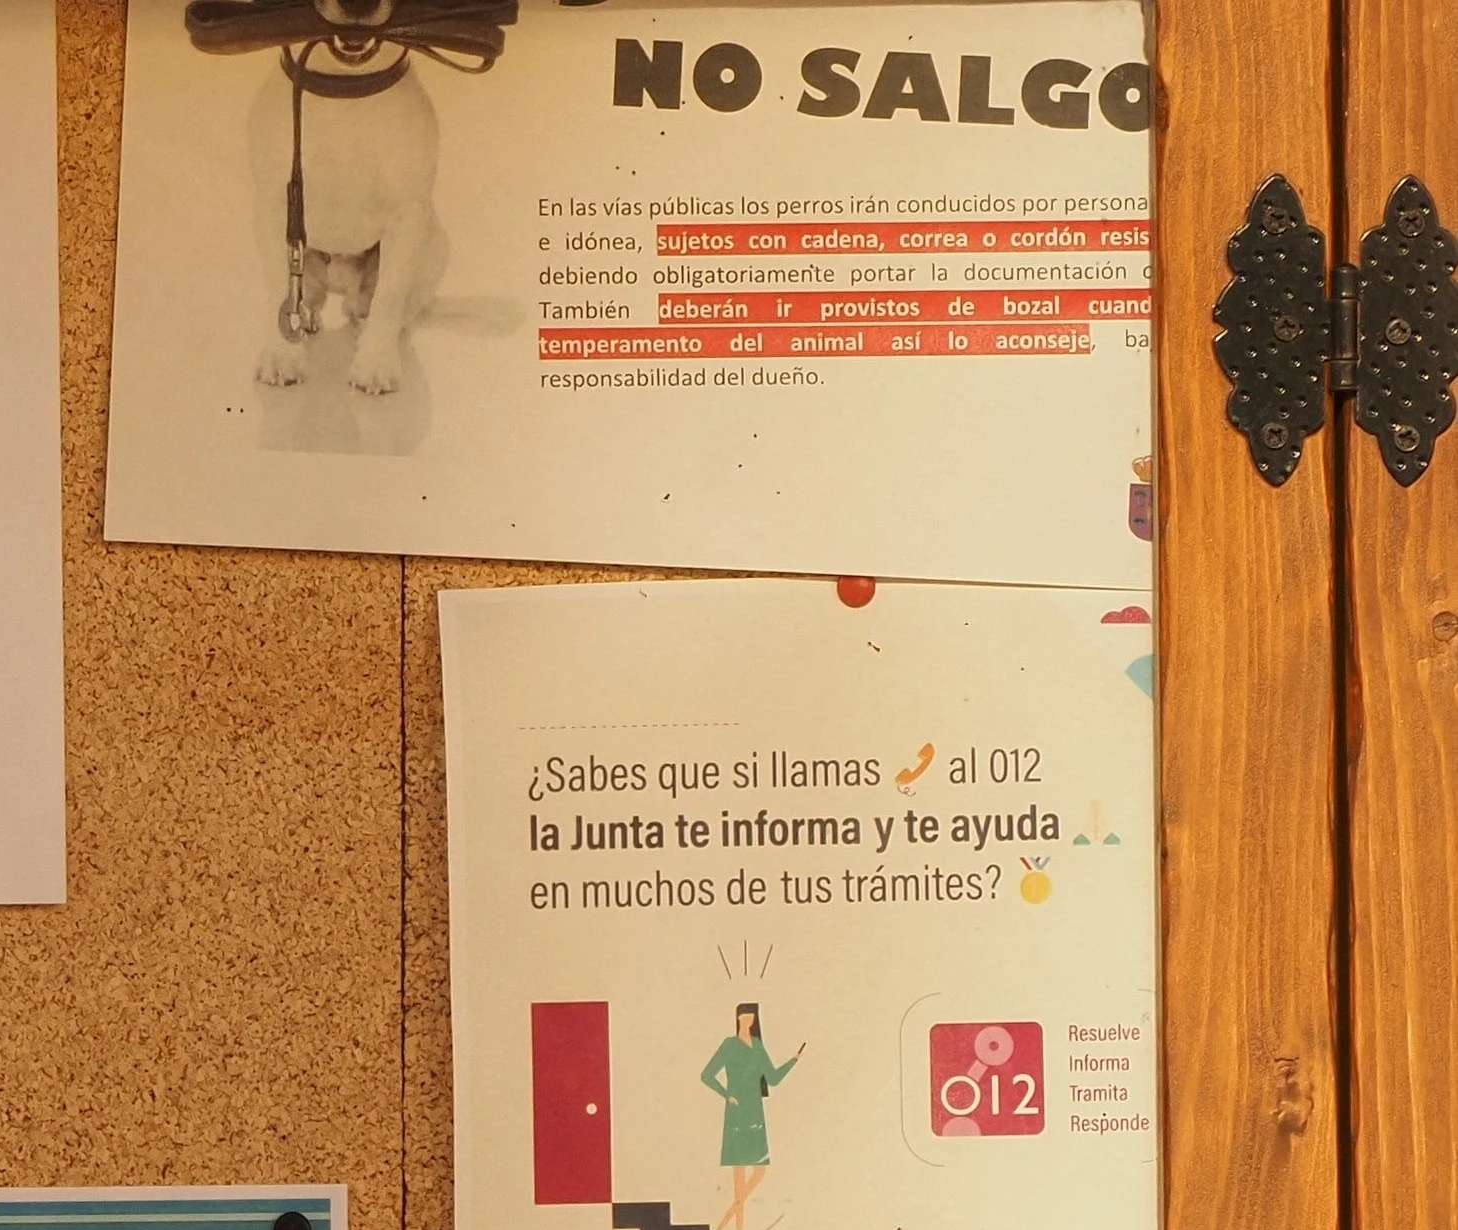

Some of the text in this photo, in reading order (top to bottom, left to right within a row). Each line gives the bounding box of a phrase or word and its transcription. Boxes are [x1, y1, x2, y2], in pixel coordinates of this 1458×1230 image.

[613, 38, 1151, 133] NO SALGO
[541, 367, 825, 391] responsabilidad del dueño.
[529, 747, 1041, 801] ¿Sabes que si llamas al 012
[1069, 1024, 1140, 1041] Resuelve
[1070, 1054, 1129, 1071] Informa
[940, 1073, 1041, 1117] 012
[1070, 1084, 1127, 1101] Tramita
[1071, 1113, 1149, 1135] Responde
